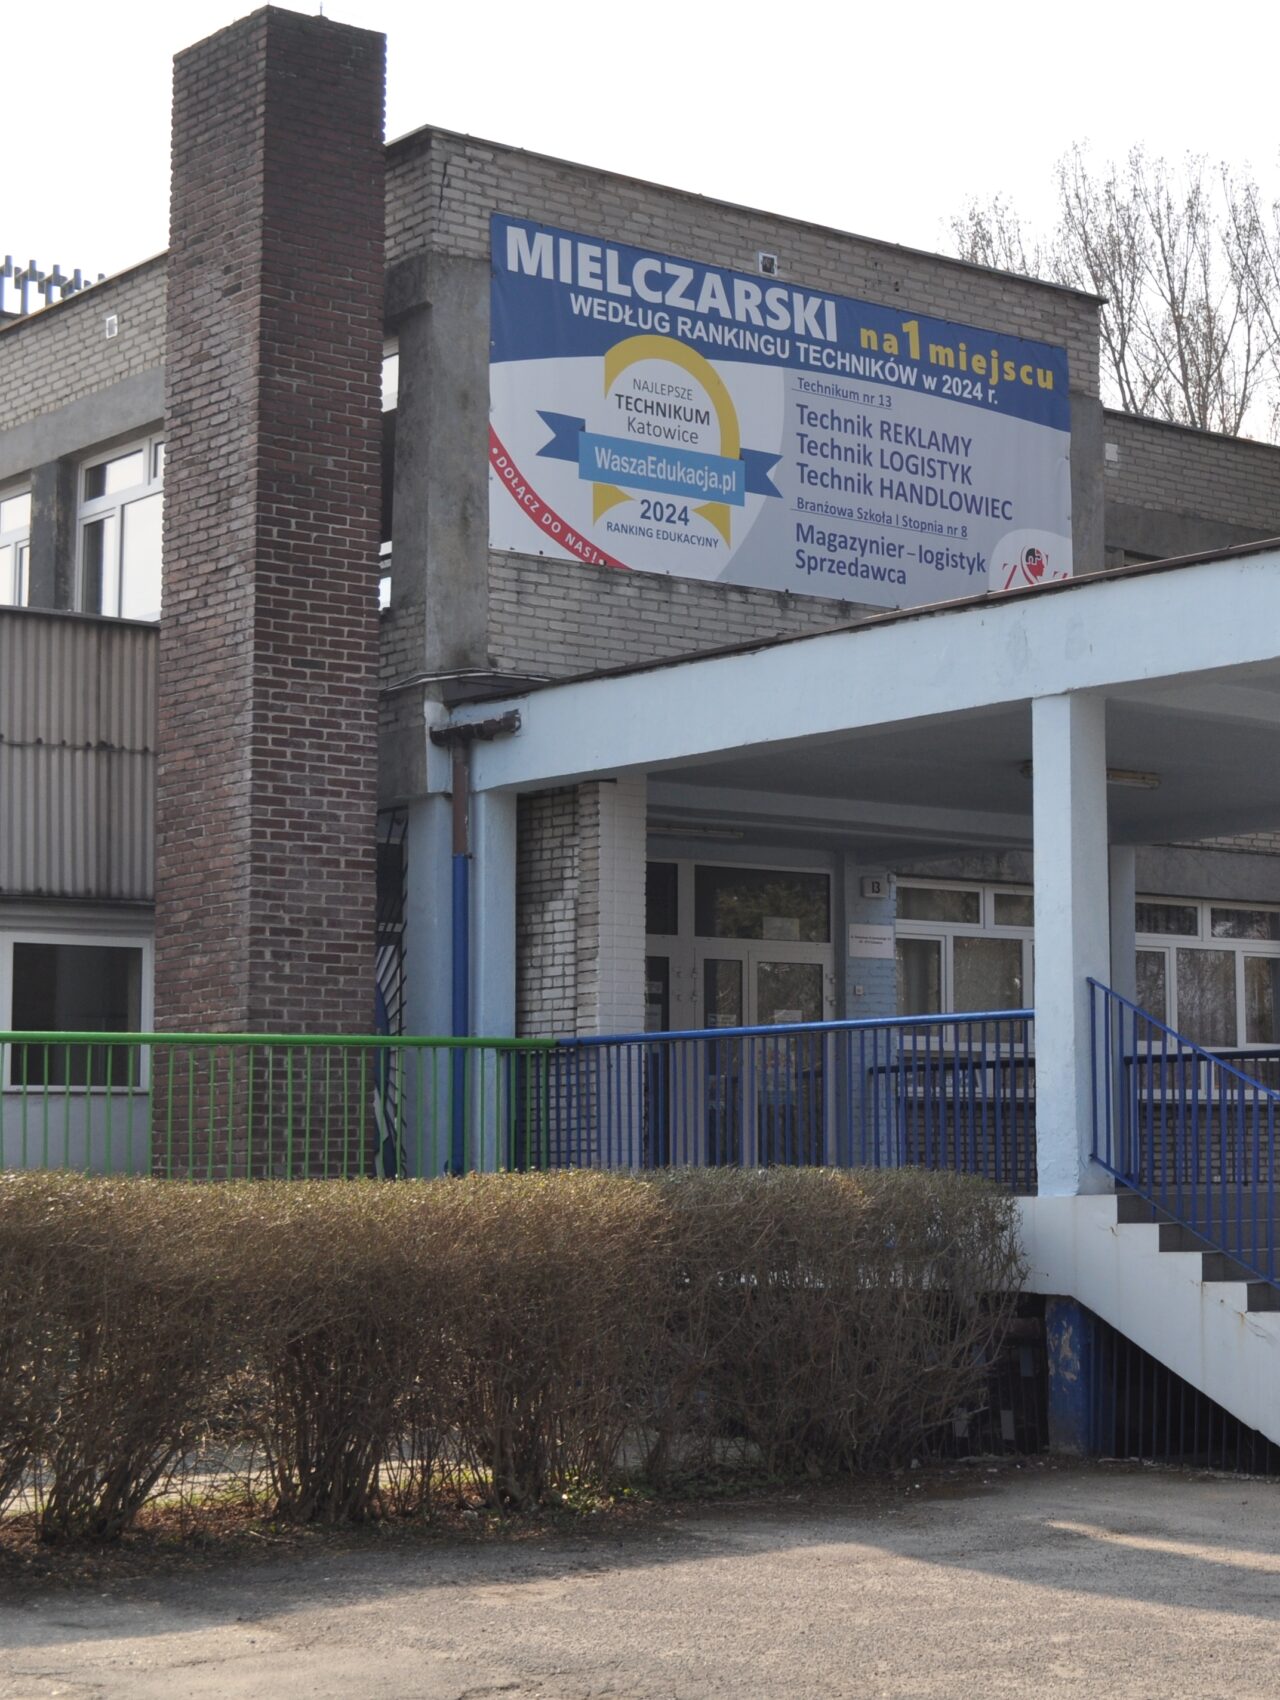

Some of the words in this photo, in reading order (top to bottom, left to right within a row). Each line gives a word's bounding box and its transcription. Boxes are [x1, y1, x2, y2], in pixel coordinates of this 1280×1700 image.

[506, 225, 838, 342] MIELCZARSKI
[569, 292, 671, 333] WEDŁUG
[677, 315, 790, 359] RANKINGU
[796, 342, 918, 387] TECHNIKÓW
[922, 373, 938, 391] w
[942, 375, 983, 401] 2024
[988, 388, 998, 405] r.
[860, 327, 898, 356] na
[902, 320, 920, 360] 1
[929, 342, 1054, 390] miejscu
[615, 393, 711, 426] TECHNIKUM
[633, 378, 694, 401] NAJLEPSZE
[797, 376, 860, 400] Technikum
[863, 393, 875, 404] nr
[878, 394, 893, 408] 13
[627, 416, 700, 445] Katowice
[796, 403, 873, 439] Technik
[880, 420, 972, 458] REKLAMY
[595, 446, 736, 495] WaszaEdukacja.pl
[796, 432, 873, 468] Technik
[880, 448, 973, 486] LOGISTYK
[496, 456, 540, 513] DOŁĄCZ
[542, 513, 562, 534] DO
[564, 533, 598, 563] NAS!
[639, 499, 690, 526] 2024
[796, 462, 873, 497] Technik
[880, 477, 1013, 521] HANDLOWIEC
[606, 521, 653, 539] RANKING
[656, 529, 719, 549] EDUKACYJNY
[797, 496, 854, 519] Branżowa
[857, 507, 892, 526] Szkoła
[902, 515, 943, 538] Stopnia
[947, 525, 958, 537] nr
[961, 525, 968, 538] 8
[795, 549, 907, 585] Sprzedawca
